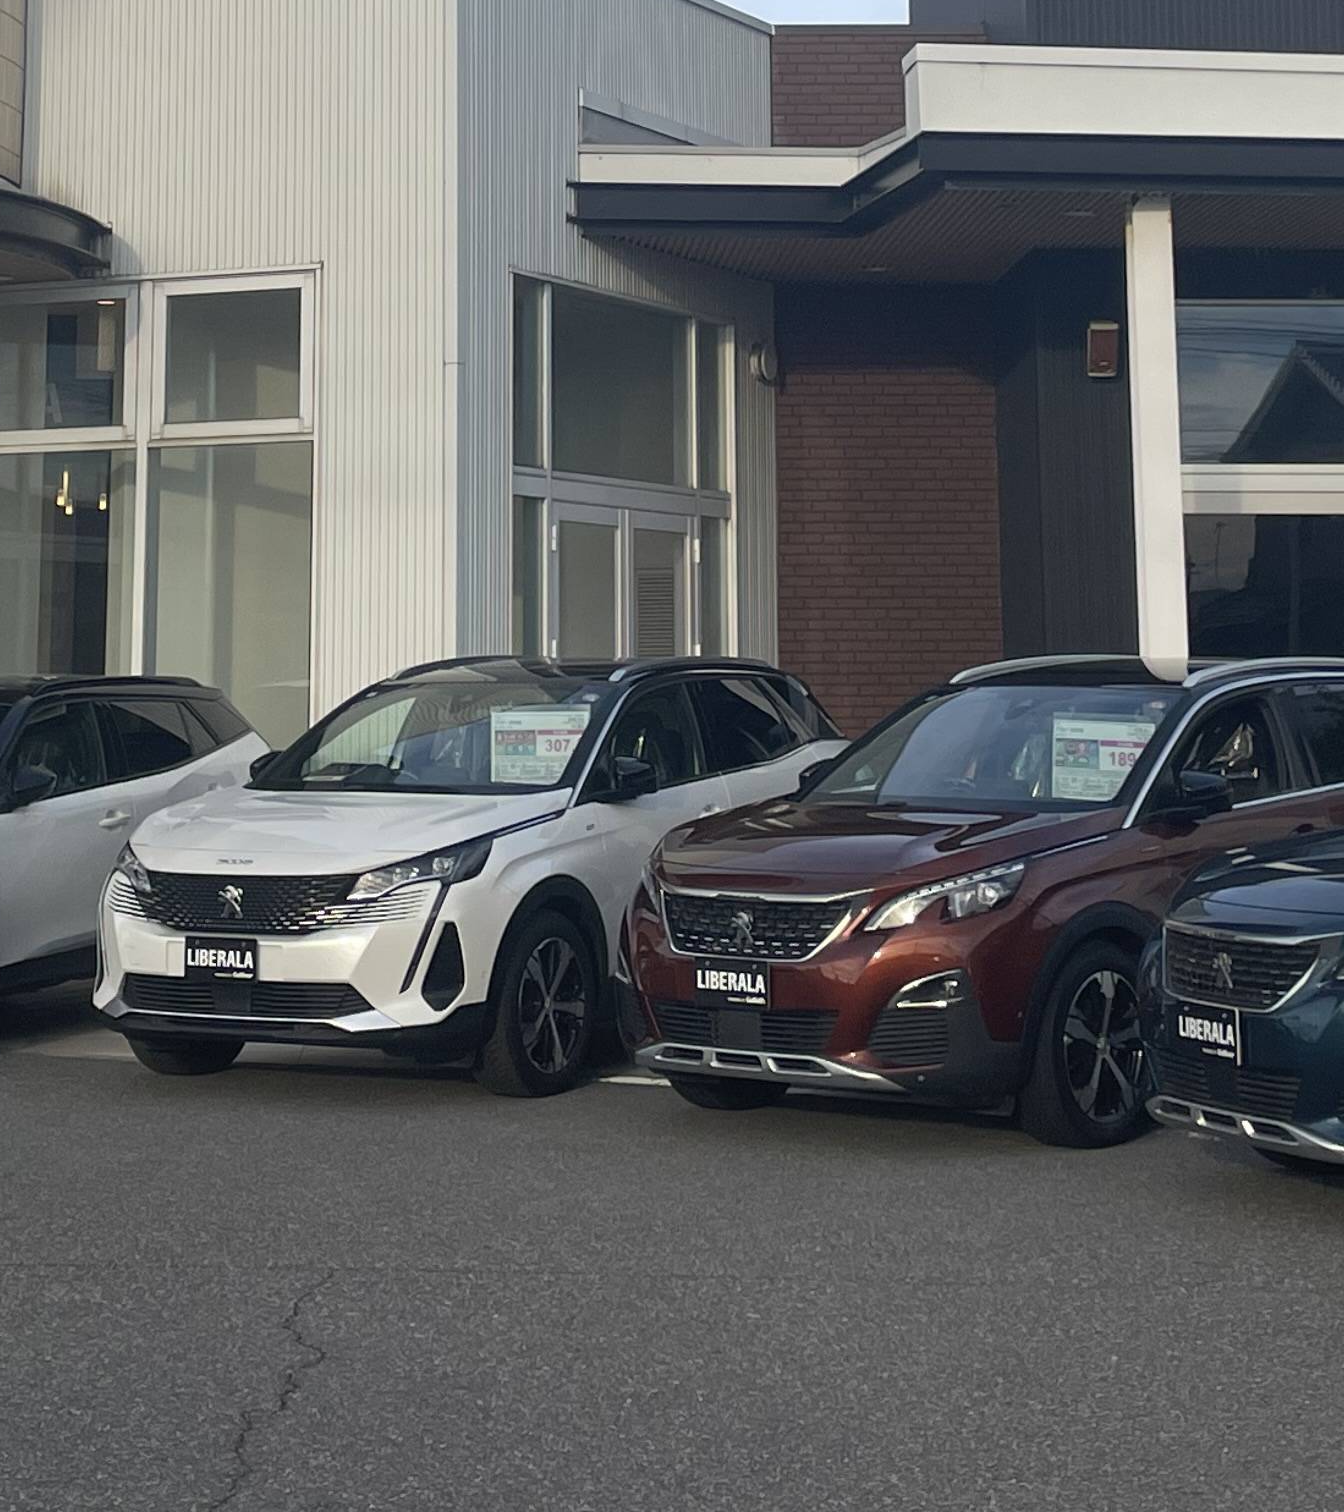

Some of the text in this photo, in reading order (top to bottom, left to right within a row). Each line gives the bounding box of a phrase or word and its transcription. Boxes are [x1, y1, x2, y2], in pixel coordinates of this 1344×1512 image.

[187, 948, 254, 969] LIBERALA
[697, 969, 766, 994] LIBERALA
[1178, 1015, 1235, 1047] LIBERALA
